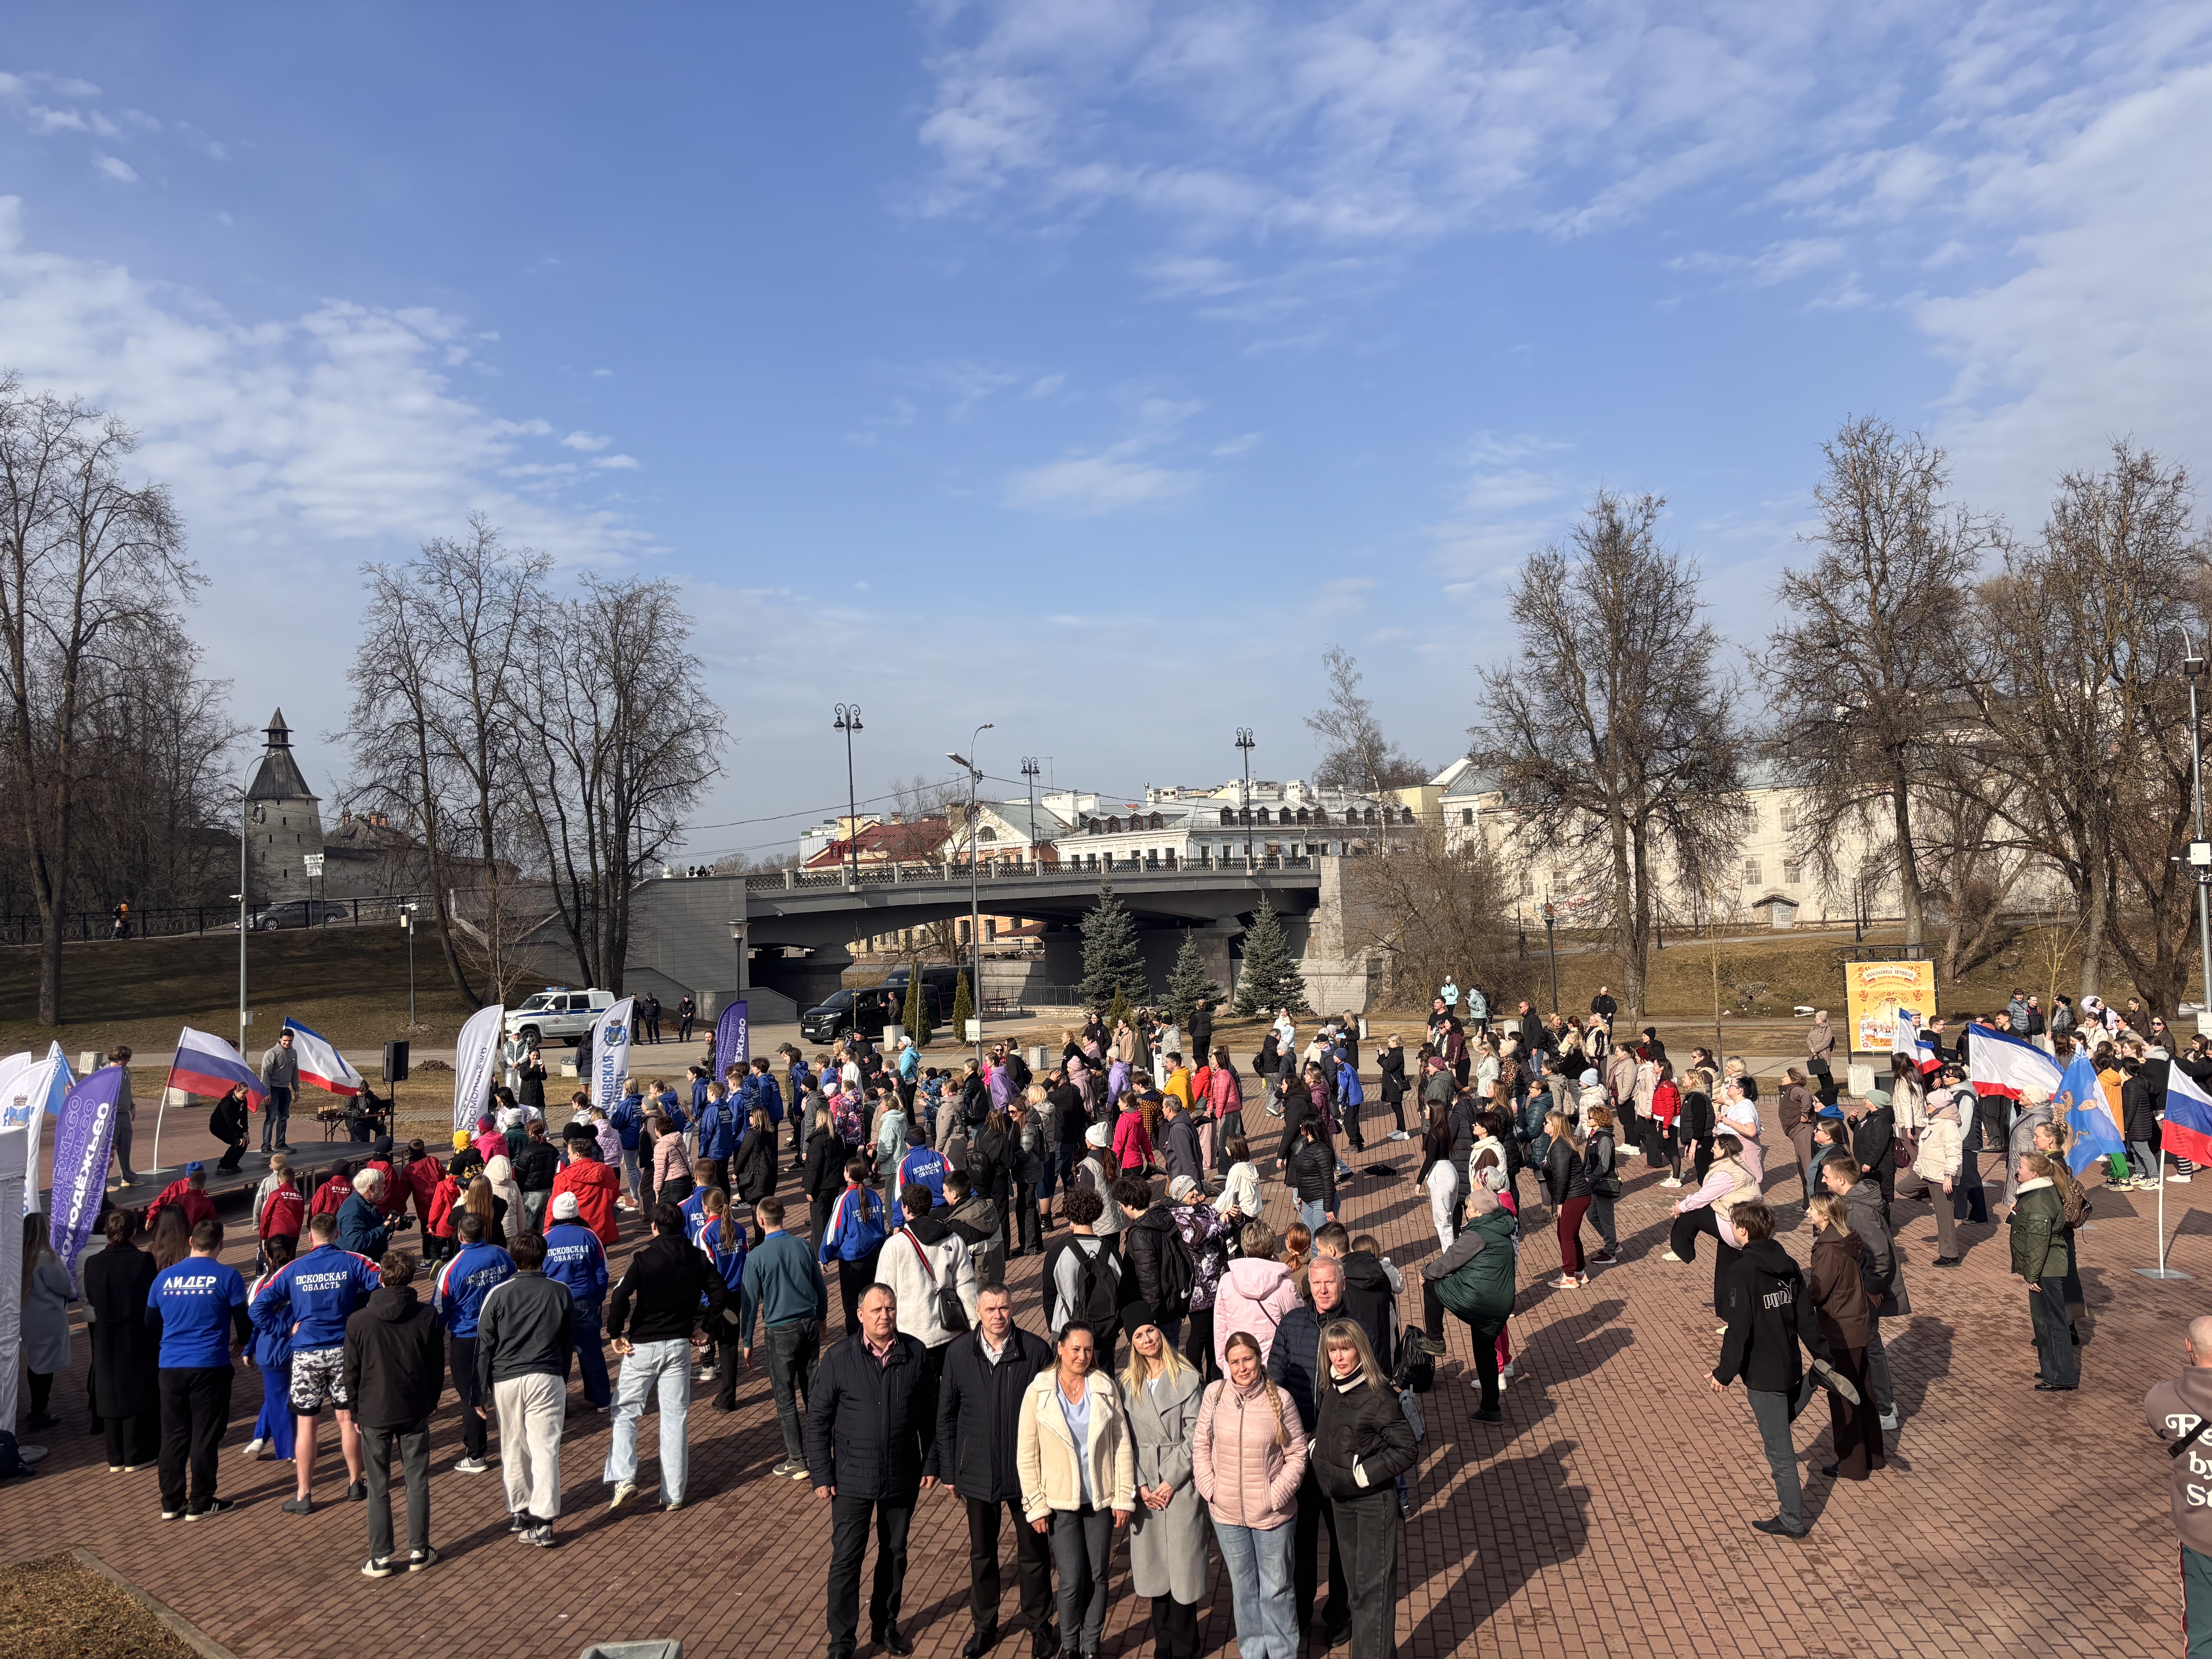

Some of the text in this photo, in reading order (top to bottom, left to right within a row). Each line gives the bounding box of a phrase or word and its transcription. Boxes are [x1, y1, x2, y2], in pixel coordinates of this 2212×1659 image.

[734, 1018, 746, 1063] ЁЖЬ60
[547, 1245, 589, 1257] ПСКОВСКАЯ
[553, 1253, 584, 1262] ОБЛАСТЬ
[163, 1276, 217, 1288] ЛИДЕР
[296, 1271, 348, 1285] ПСКОВСКАЯ
[302, 1281, 340, 1292] ОБЛАСТЬ
[1763, 1291, 1791, 1309] PUMA
[2187, 1483, 2212, 1508] St
